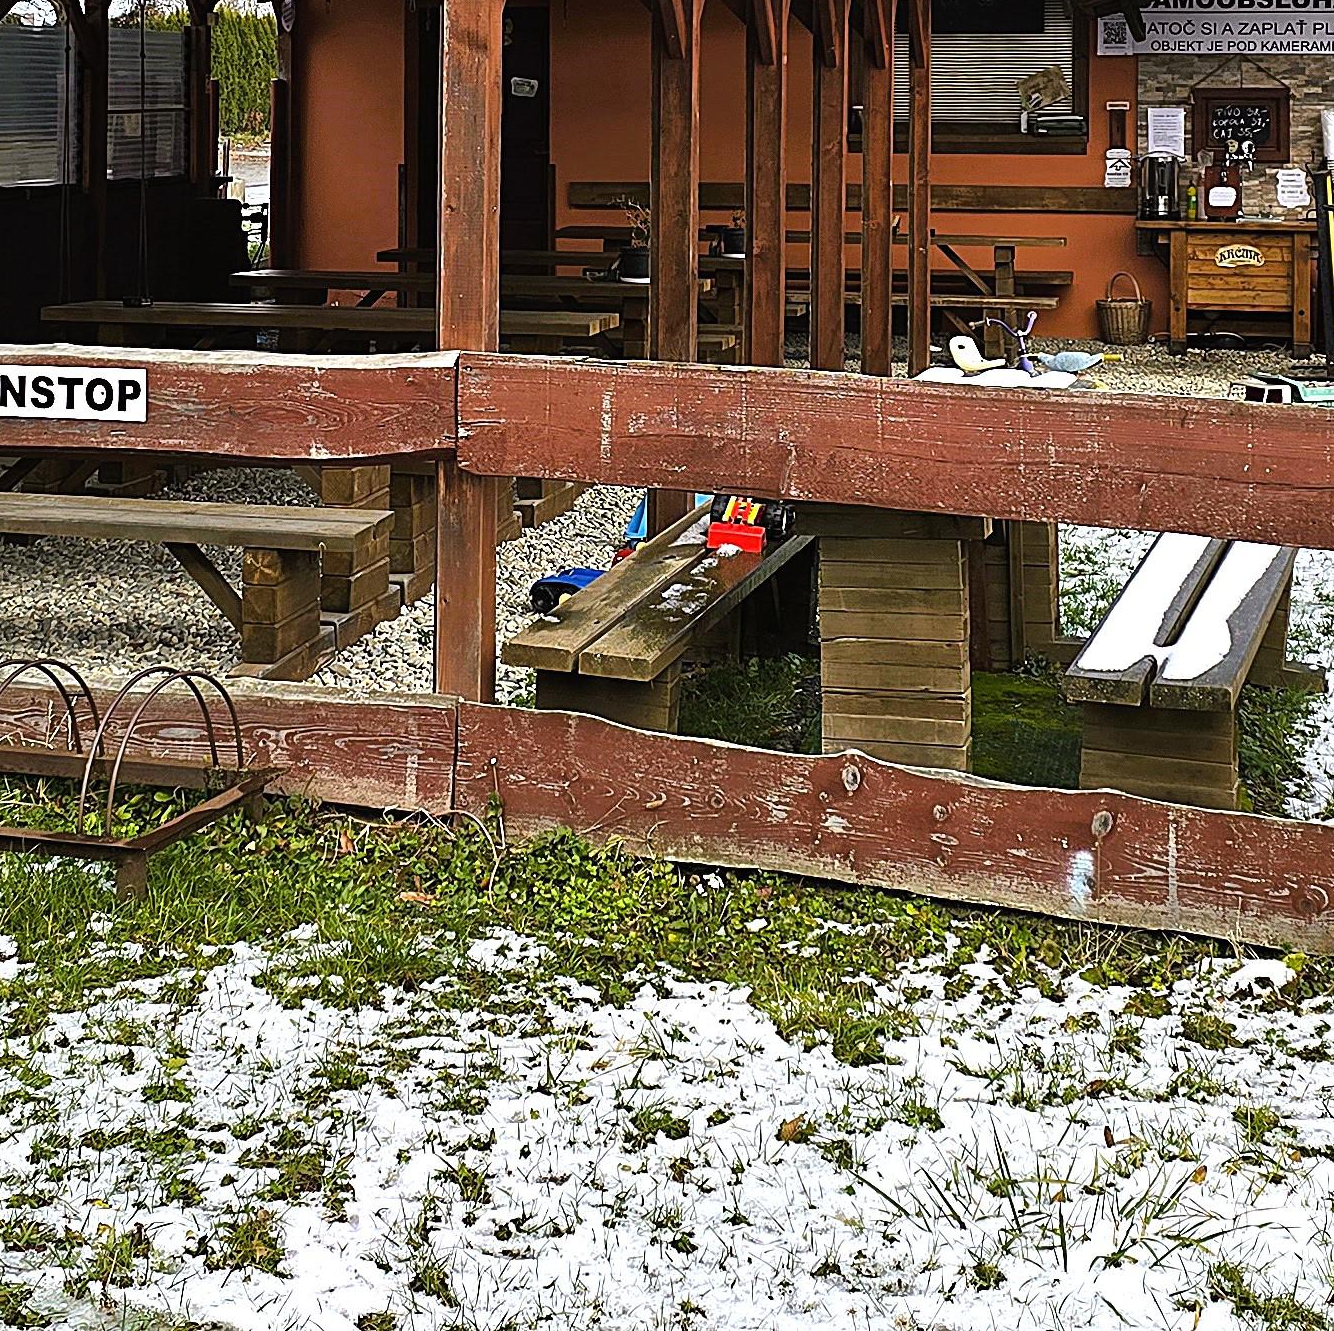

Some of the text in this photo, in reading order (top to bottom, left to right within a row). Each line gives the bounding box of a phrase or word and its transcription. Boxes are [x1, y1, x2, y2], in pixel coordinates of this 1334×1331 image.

[1143, 19, 1196, 36] ATOČ
[1200, 22, 1217, 36] SI
[1221, 22, 1235, 35] A
[1237, 19, 1308, 36] ZAPLAŤ
[1150, 40, 1334, 52] OBJEKT JE POD KAMERAMI
